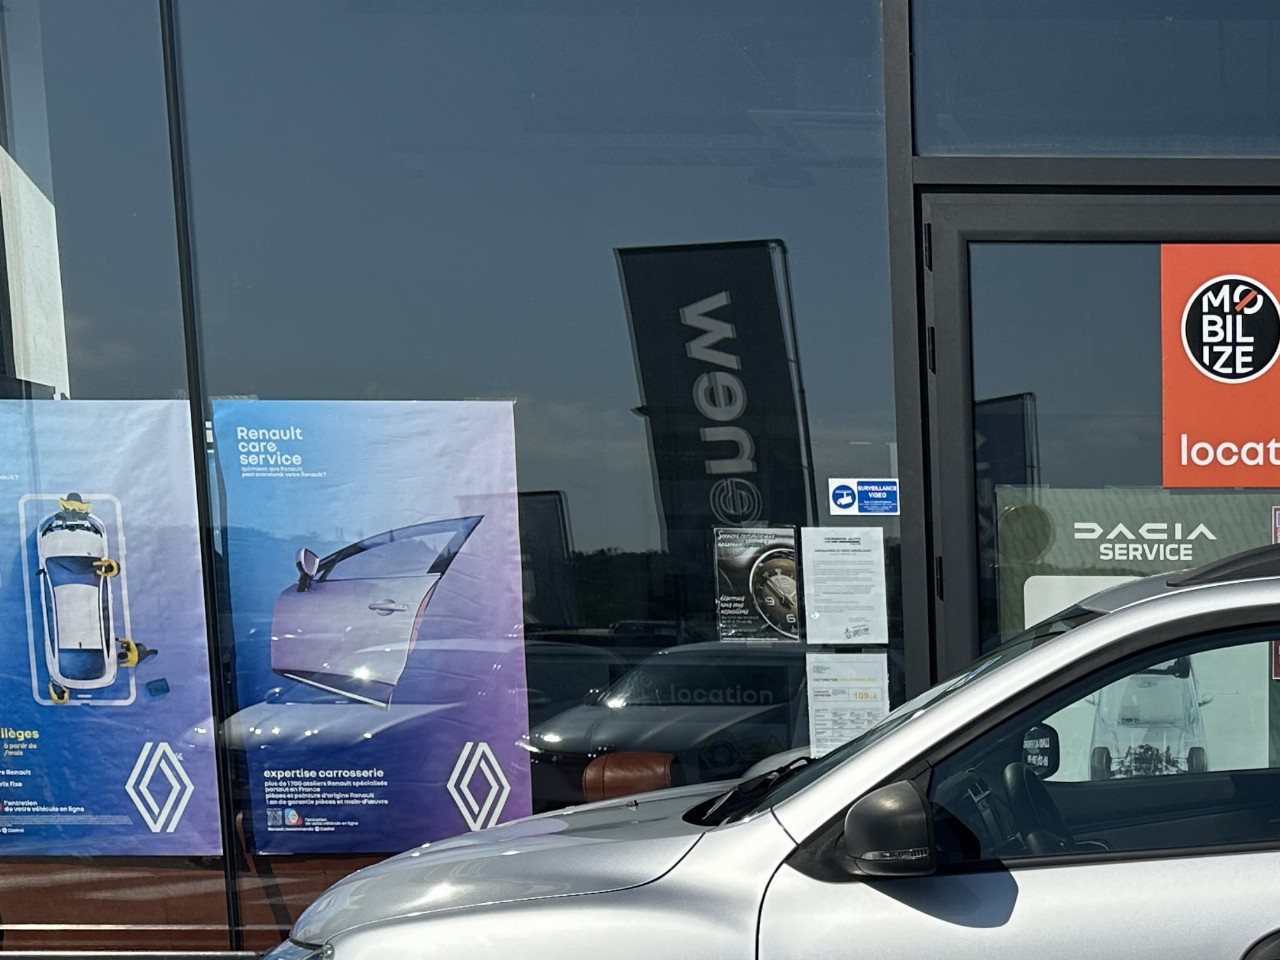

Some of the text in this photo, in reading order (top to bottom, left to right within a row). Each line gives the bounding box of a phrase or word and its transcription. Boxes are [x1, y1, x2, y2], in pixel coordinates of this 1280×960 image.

[236, 426, 304, 441] Renault
[238, 441, 278, 453] care
[239, 452, 302, 466] service
[1074, 522, 1217, 540] DACIA
[1099, 543, 1193, 561] SERVICE
[263, 767, 385, 780] expertise carrosserie
